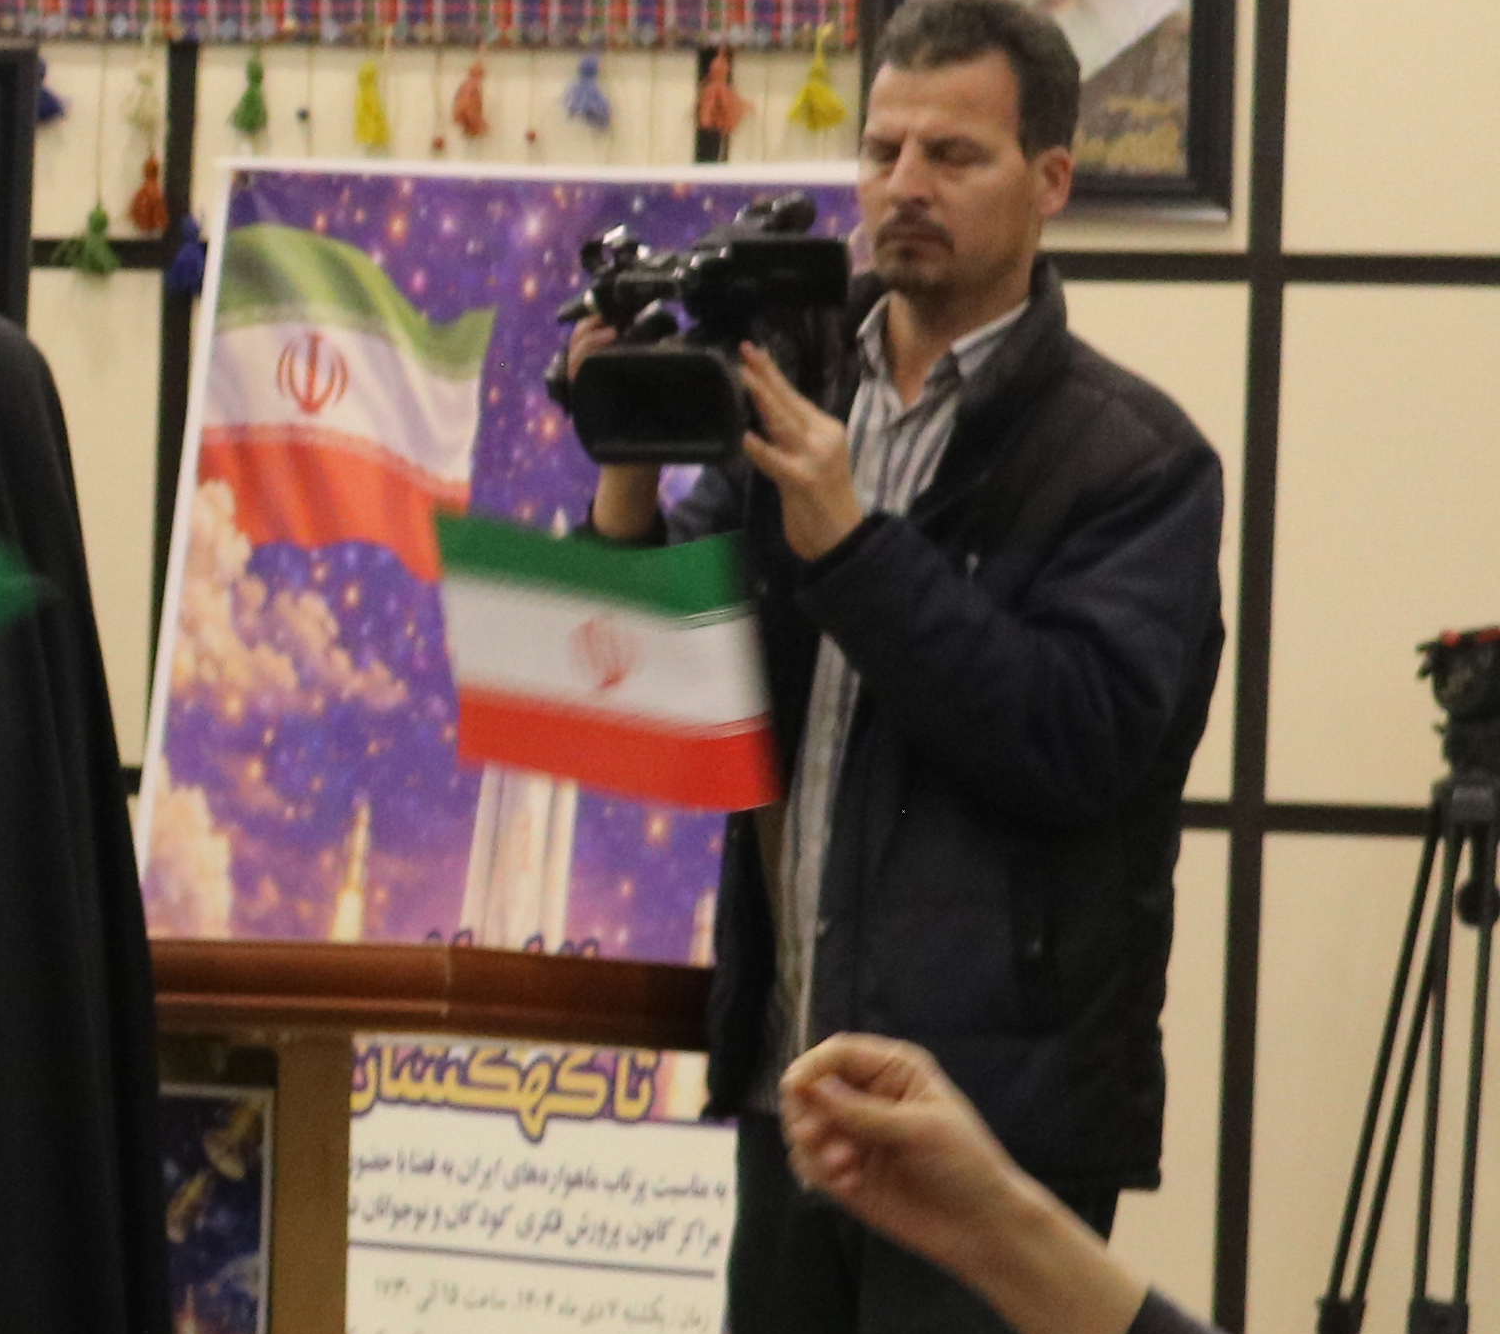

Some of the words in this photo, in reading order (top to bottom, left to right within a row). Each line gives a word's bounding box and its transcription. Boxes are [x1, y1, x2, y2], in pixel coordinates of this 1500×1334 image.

[612, 1047, 659, 1122] تا
[410, 1149, 436, 1175] فضا
[456, 1156, 501, 1192] ایران
[602, 1166, 648, 1205] پرتاب
[651, 1171, 709, 1203] مناسبت
[444, 1201, 515, 1241] کودکان
[515, 1207, 564, 1244] فکری
[565, 1211, 622, 1251] پرورش
[625, 1216, 676, 1253] کانون
